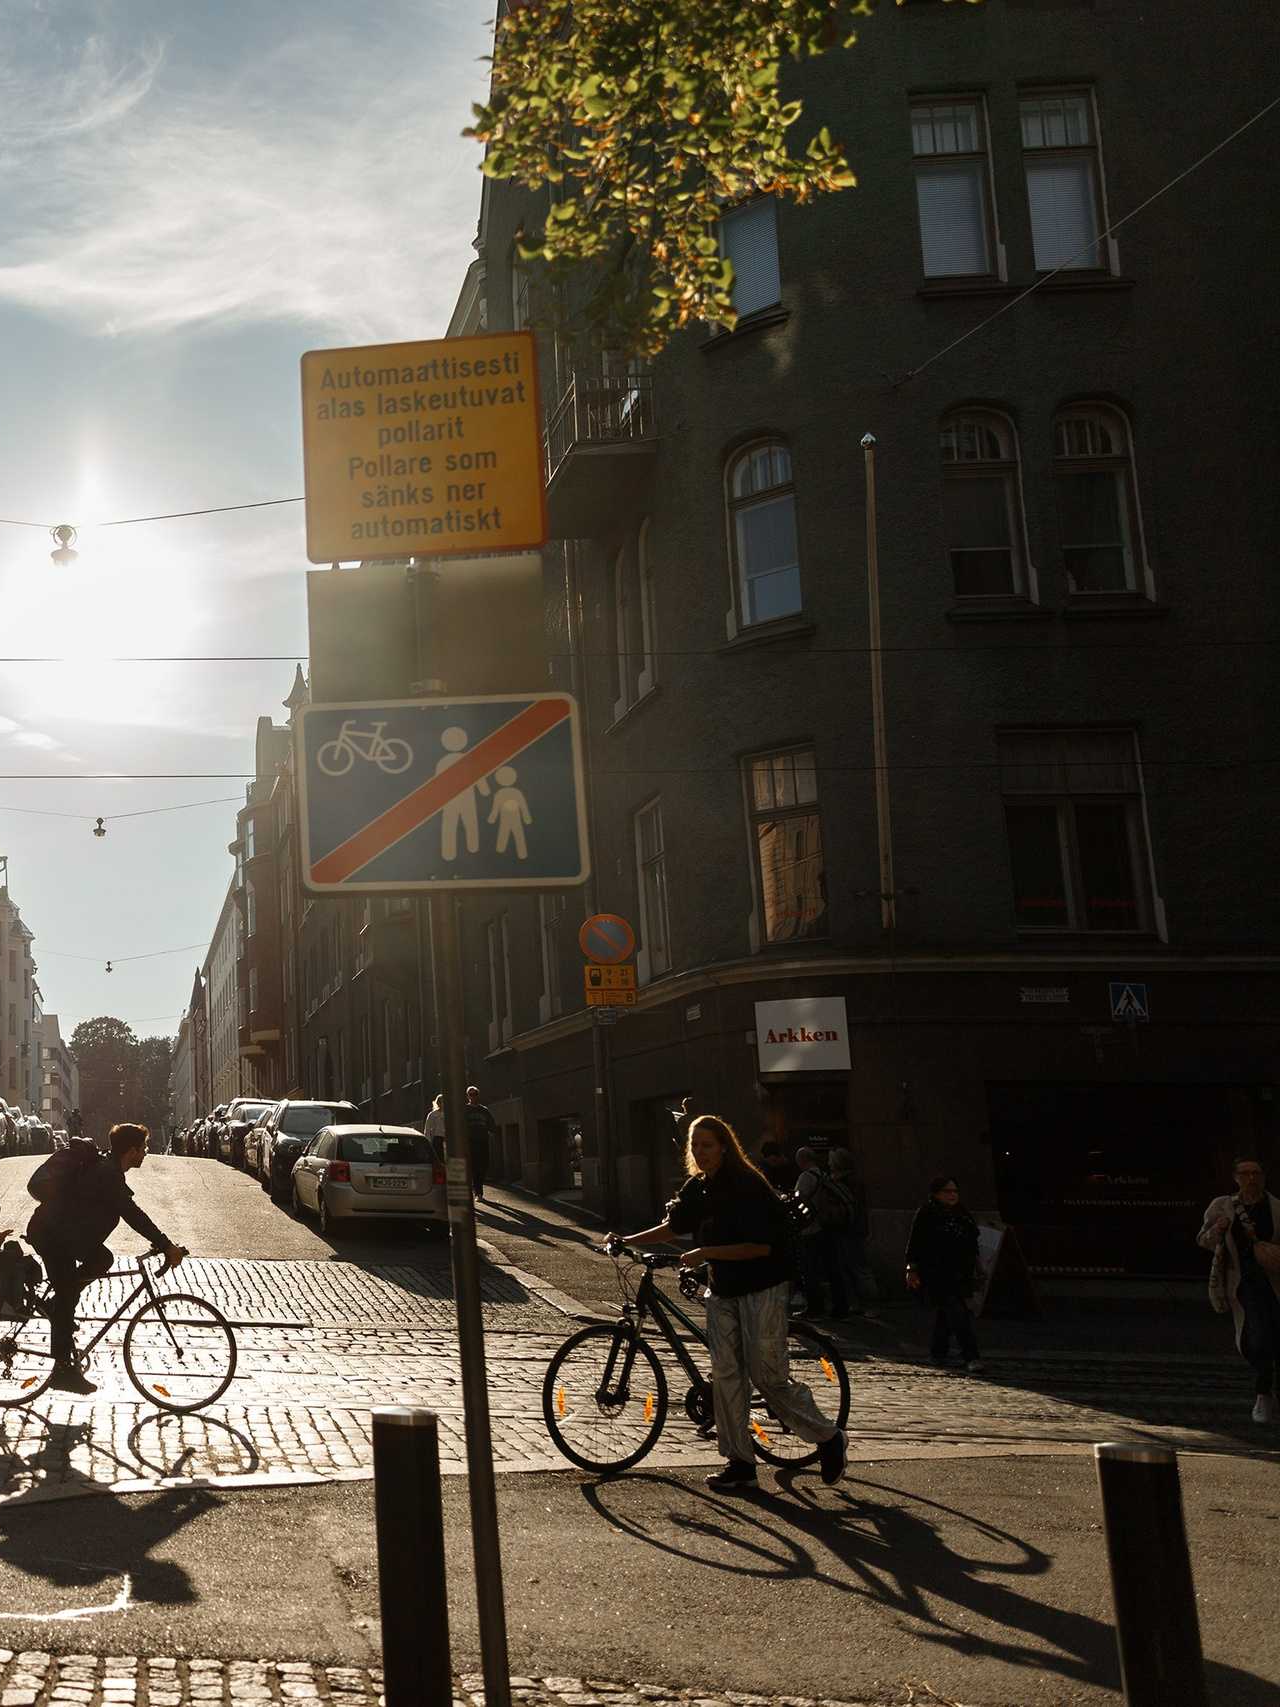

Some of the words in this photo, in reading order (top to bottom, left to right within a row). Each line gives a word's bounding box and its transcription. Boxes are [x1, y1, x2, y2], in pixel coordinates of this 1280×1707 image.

[320, 351, 520, 391] Automaattisesti
[317, 396, 365, 420] alas
[377, 381, 525, 415] laskeutuvat
[377, 416, 464, 449] pollarit
[348, 454, 433, 479] Pollare
[445, 450, 497, 472] som
[362, 482, 434, 508] sänks
[446, 481, 487, 502] ner
[350, 507, 502, 540] automatiskt
[606, 968, 612, 976] 9
[620, 968, 628, 976] 21
[626, 993, 633, 1002] B
[765, 1027, 838, 1044] Arkken
[1105, 1175, 1149, 1185] Arkken
